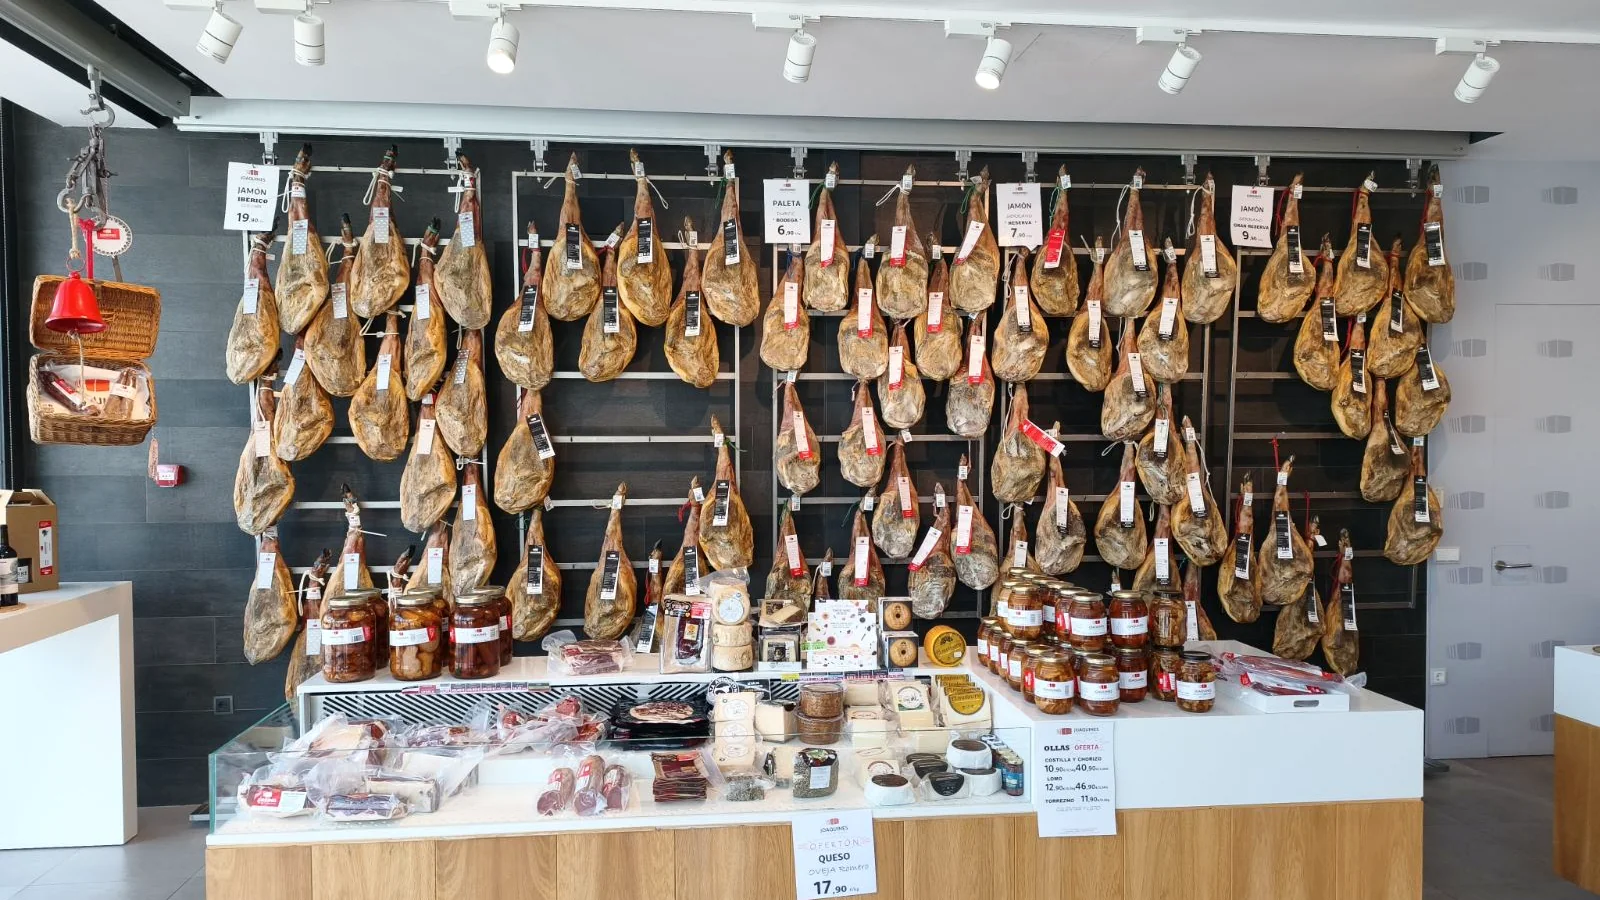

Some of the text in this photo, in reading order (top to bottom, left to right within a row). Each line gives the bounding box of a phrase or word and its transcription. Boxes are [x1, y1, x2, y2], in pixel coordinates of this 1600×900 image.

[1007, 202, 1032, 210] JAMÓN
[1240, 205, 1265, 213] JAMÓN
[1044, 744, 1070, 752] OLLAS
[819, 852, 850, 864] QUESO
